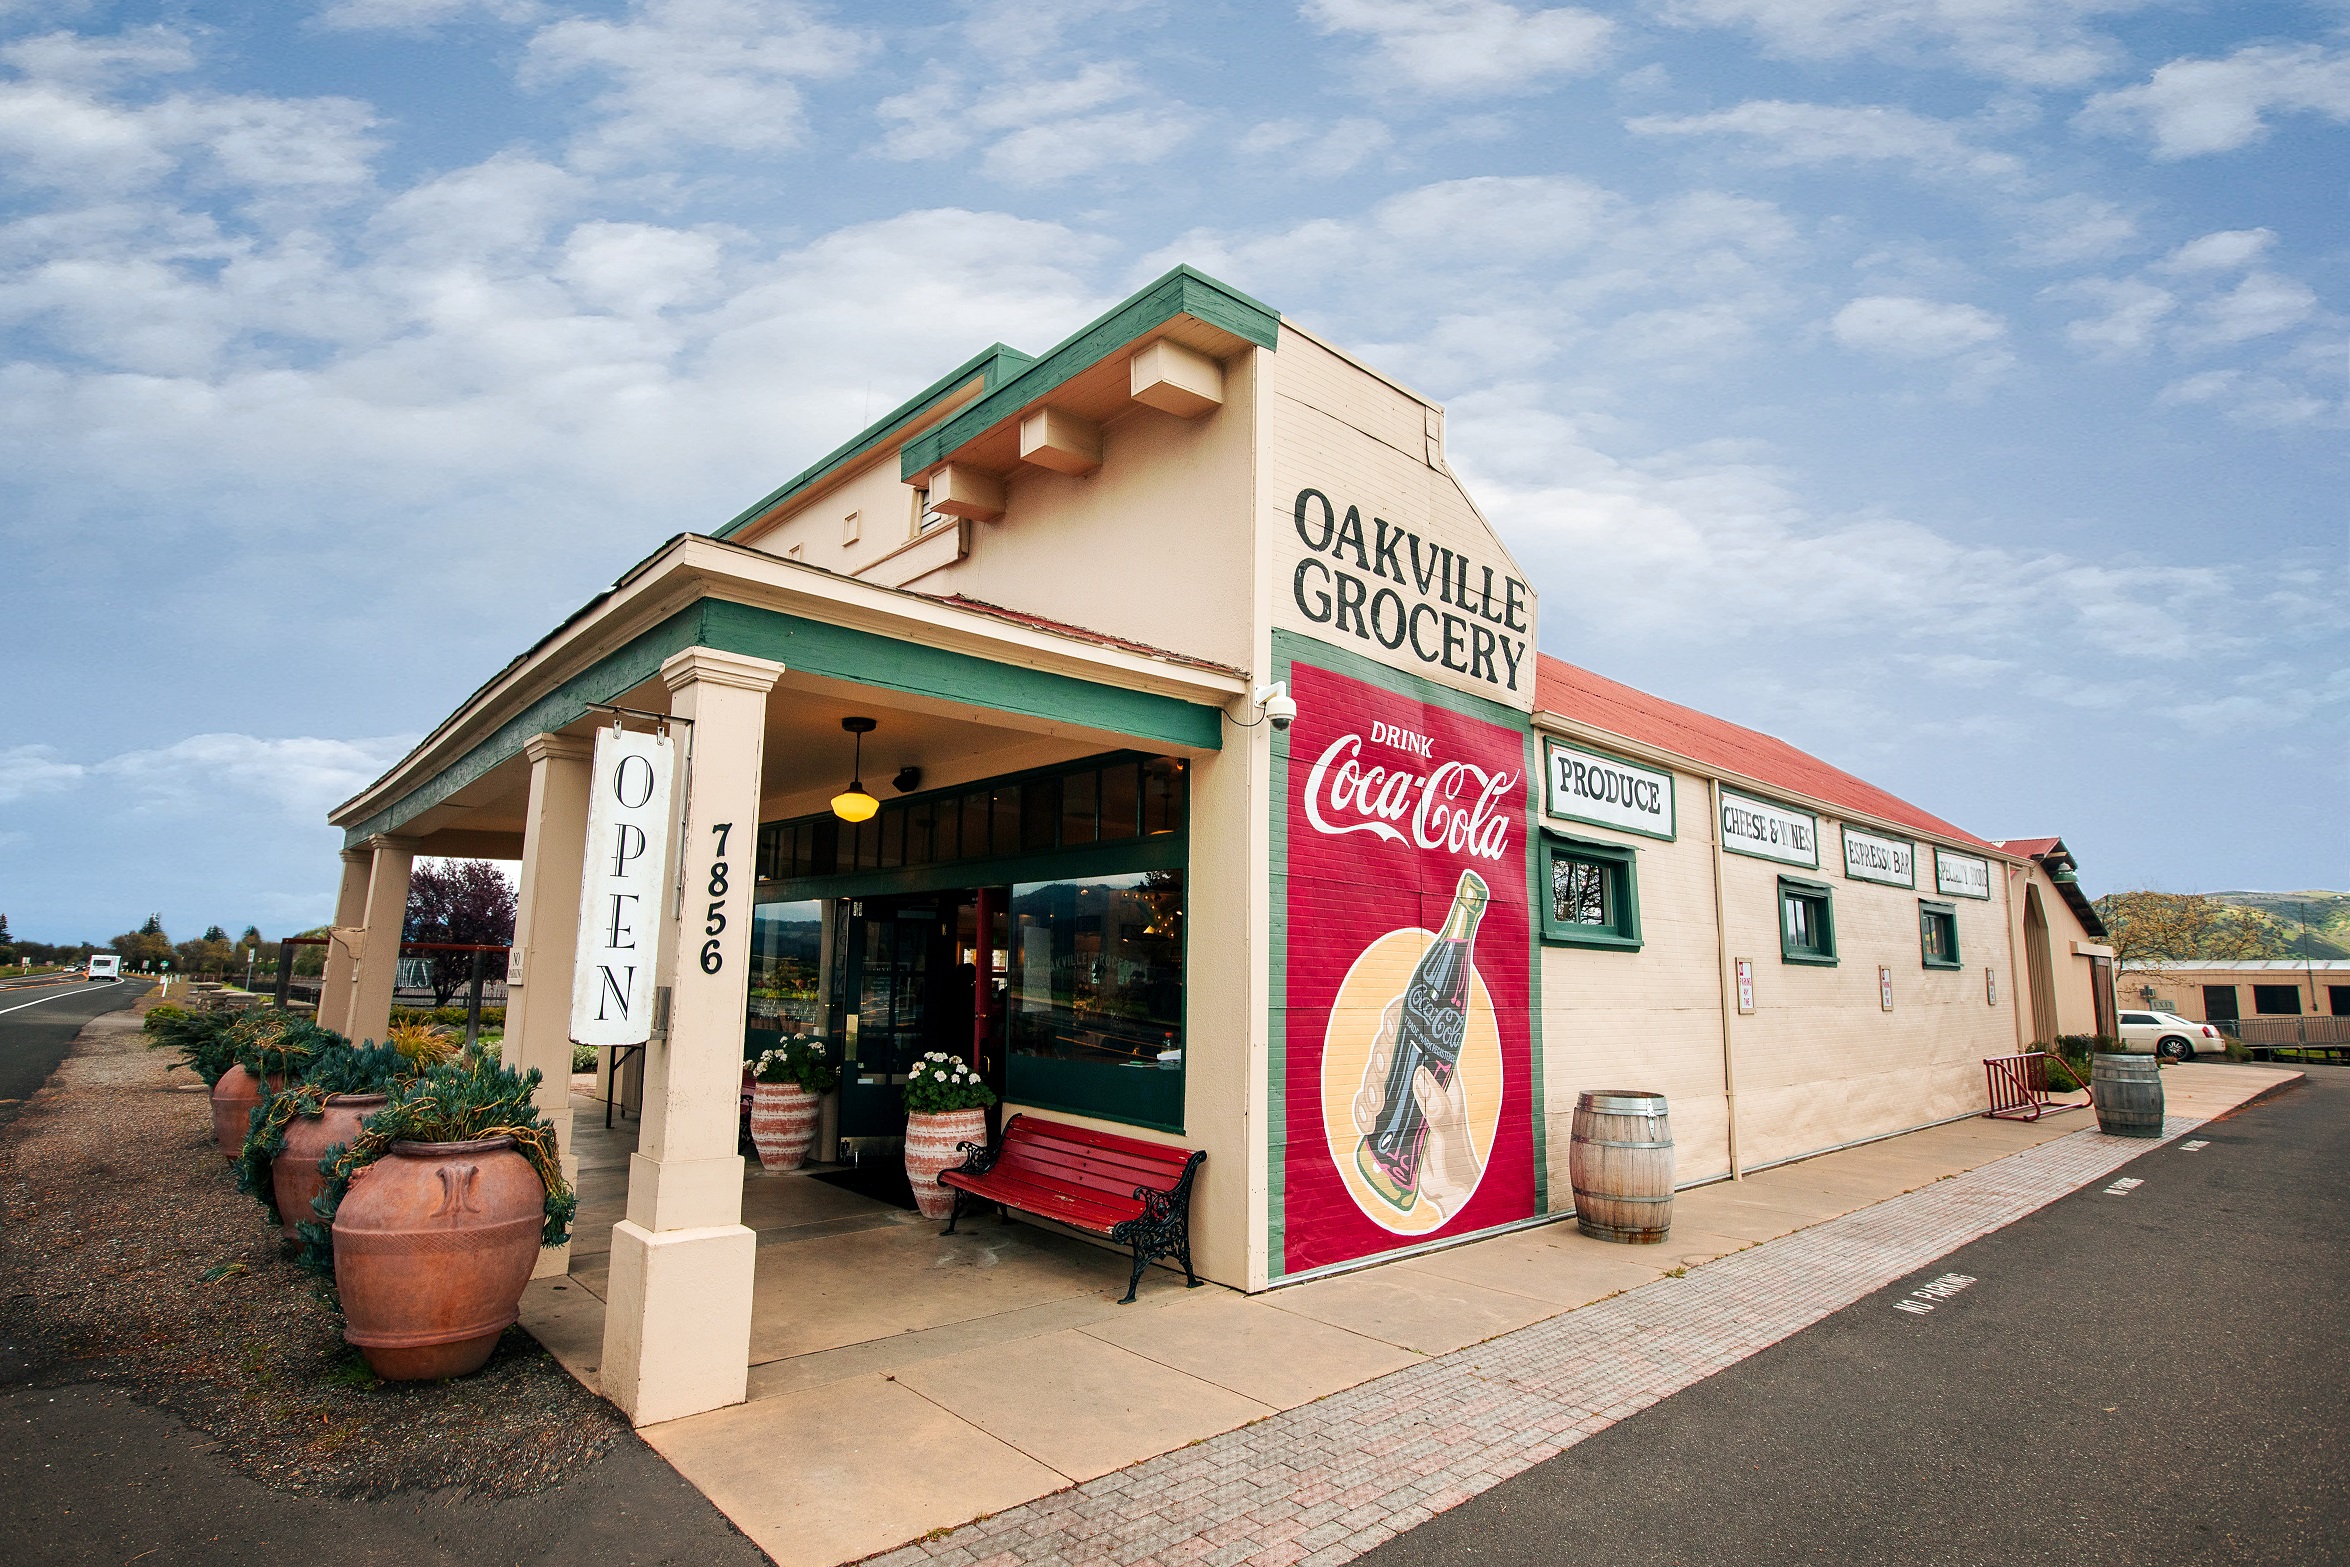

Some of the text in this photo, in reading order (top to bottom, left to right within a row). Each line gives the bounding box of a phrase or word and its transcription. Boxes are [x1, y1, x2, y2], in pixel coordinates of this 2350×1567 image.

[1294, 488, 1527, 634] OAKVILLE
[1293, 558, 1525, 691] GROCERY
[1370, 720, 1435, 759] DRINK
[1304, 734, 1521, 860] Coca-Cola
[1557, 756, 1661, 815] PRODUCE
[1723, 805, 1813, 853] CHEESE & WINES
[1847, 839, 1911, 875] ESPRESSO BAR
[594, 755, 655, 1022] OPEN
[700, 823, 733, 975] 7856
[1050, 951, 1089, 971] AKVILLE
[2153, 1001, 2173, 1009] EXIT
[1405, 1015, 1420, 1037] TRADE
[1418, 1033, 1434, 1051] MARK
[1892, 1272, 1978, 1316] NO PARKING
